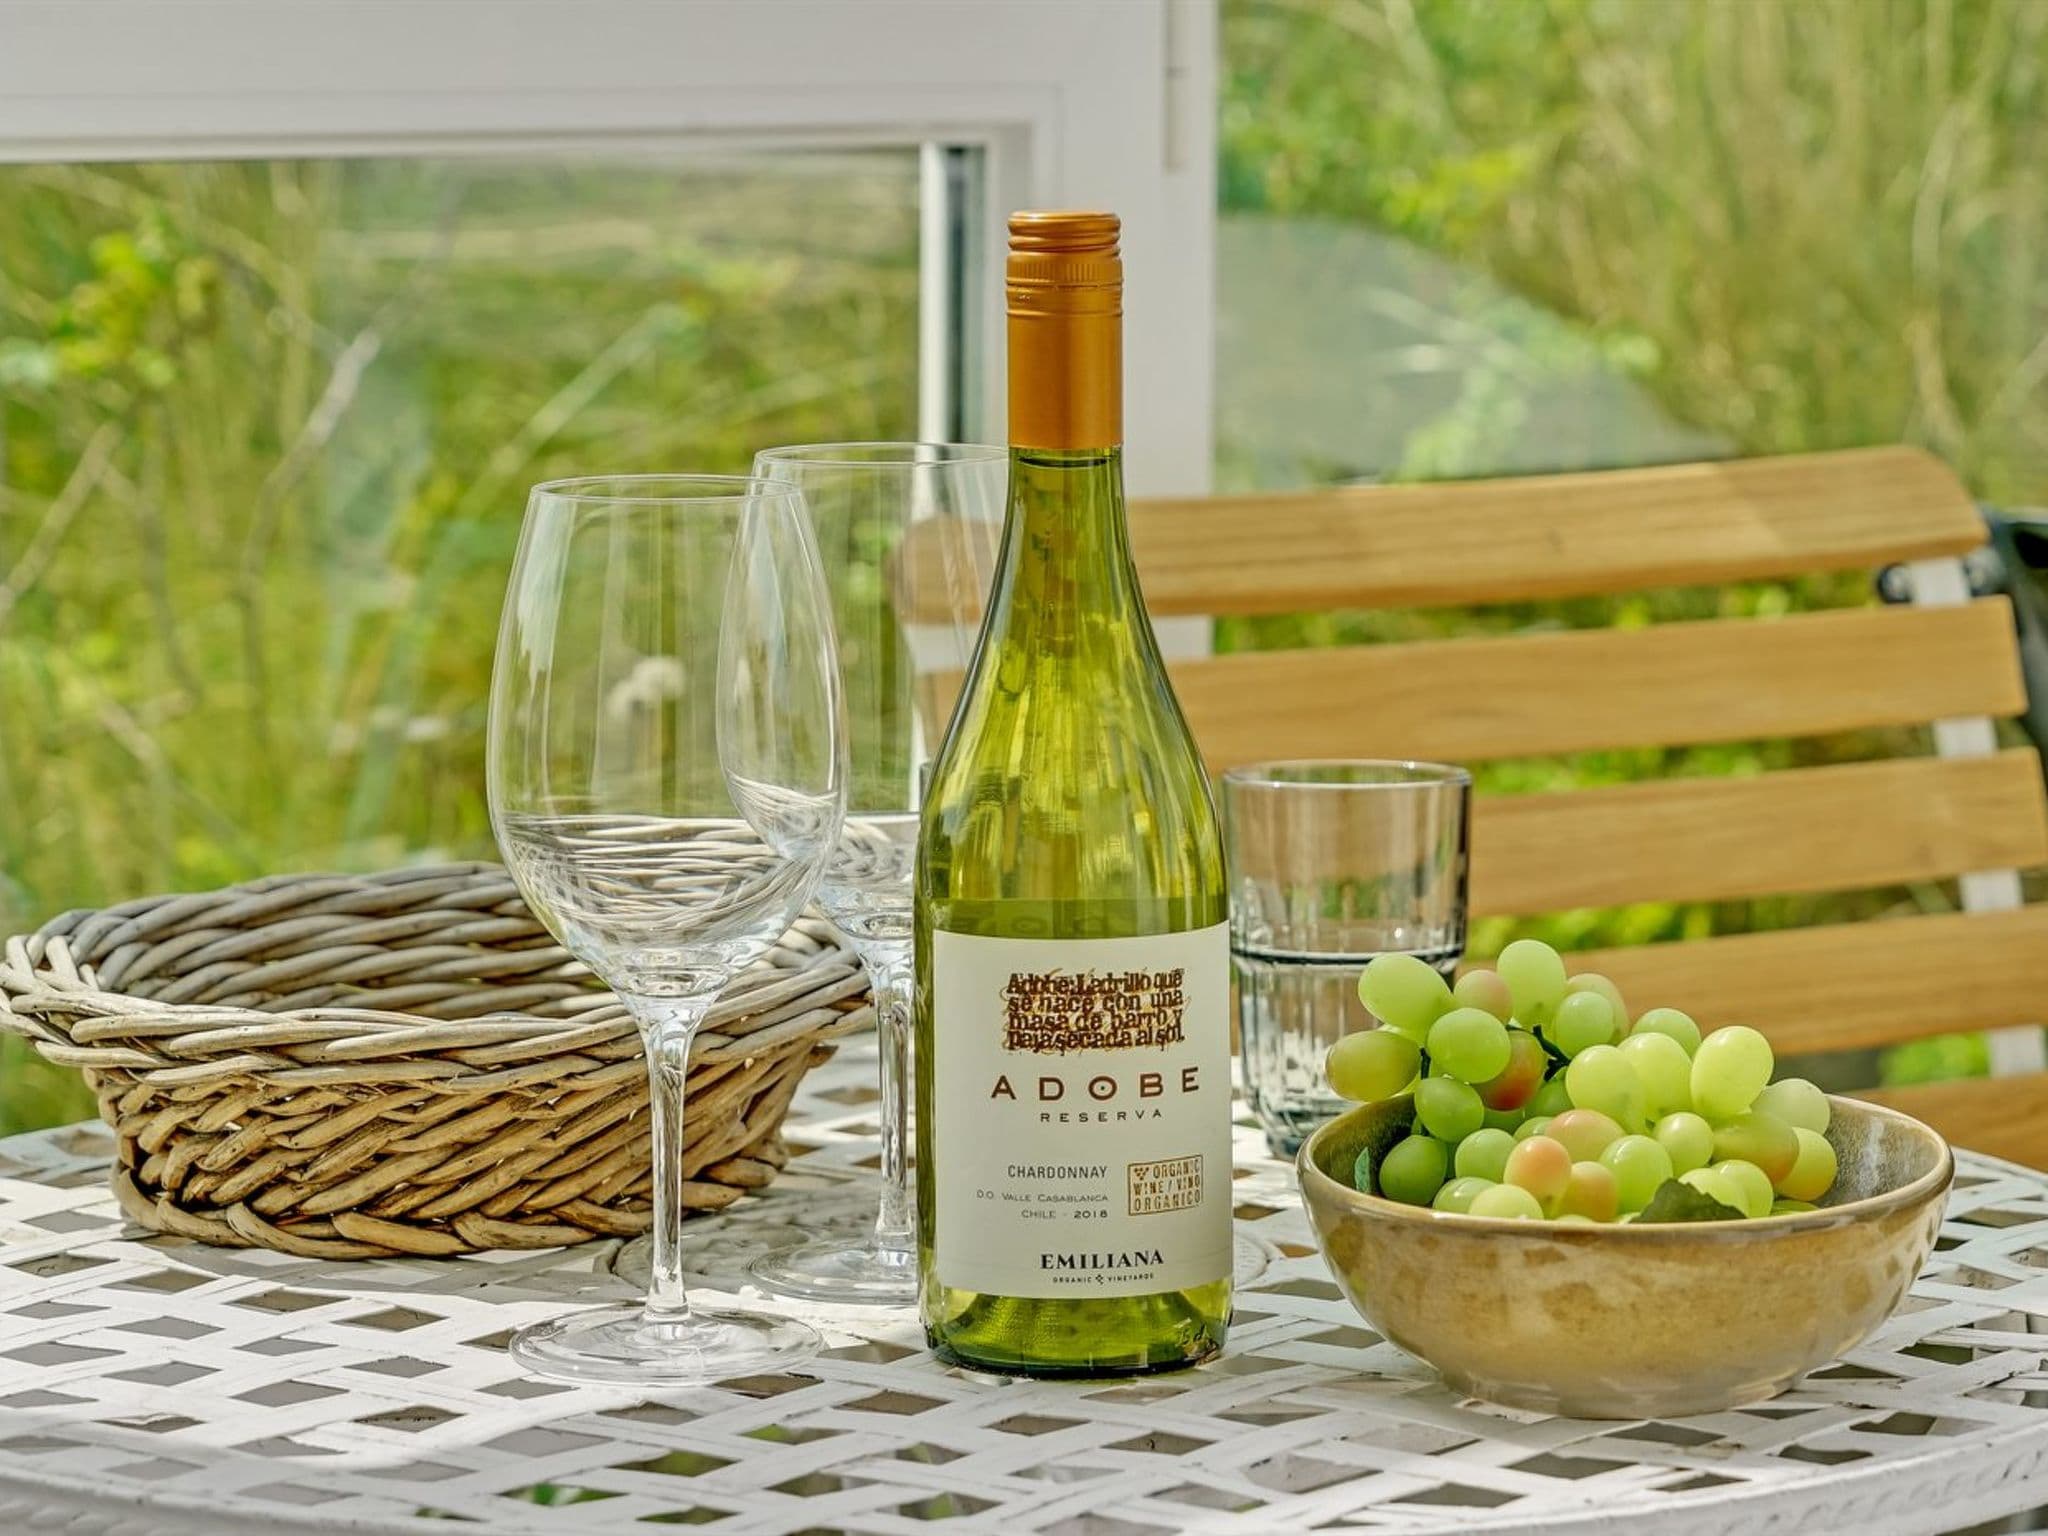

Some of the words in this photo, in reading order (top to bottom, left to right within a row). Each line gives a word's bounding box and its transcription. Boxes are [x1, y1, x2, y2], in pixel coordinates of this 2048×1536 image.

[1150, 990, 1183, 1009] una
[991, 1066, 1199, 1101] ADOBE
[1040, 1108, 1162, 1123] RESERVA
[1007, 1164, 1107, 1179] CHARDONNAY
[1153, 1158, 1200, 1179] ORGANIC
[1021, 1209, 1056, 1219] CHILE
[1073, 1209, 1108, 1219] 2018
[1040, 1249, 1164, 1270] EMILIANA
